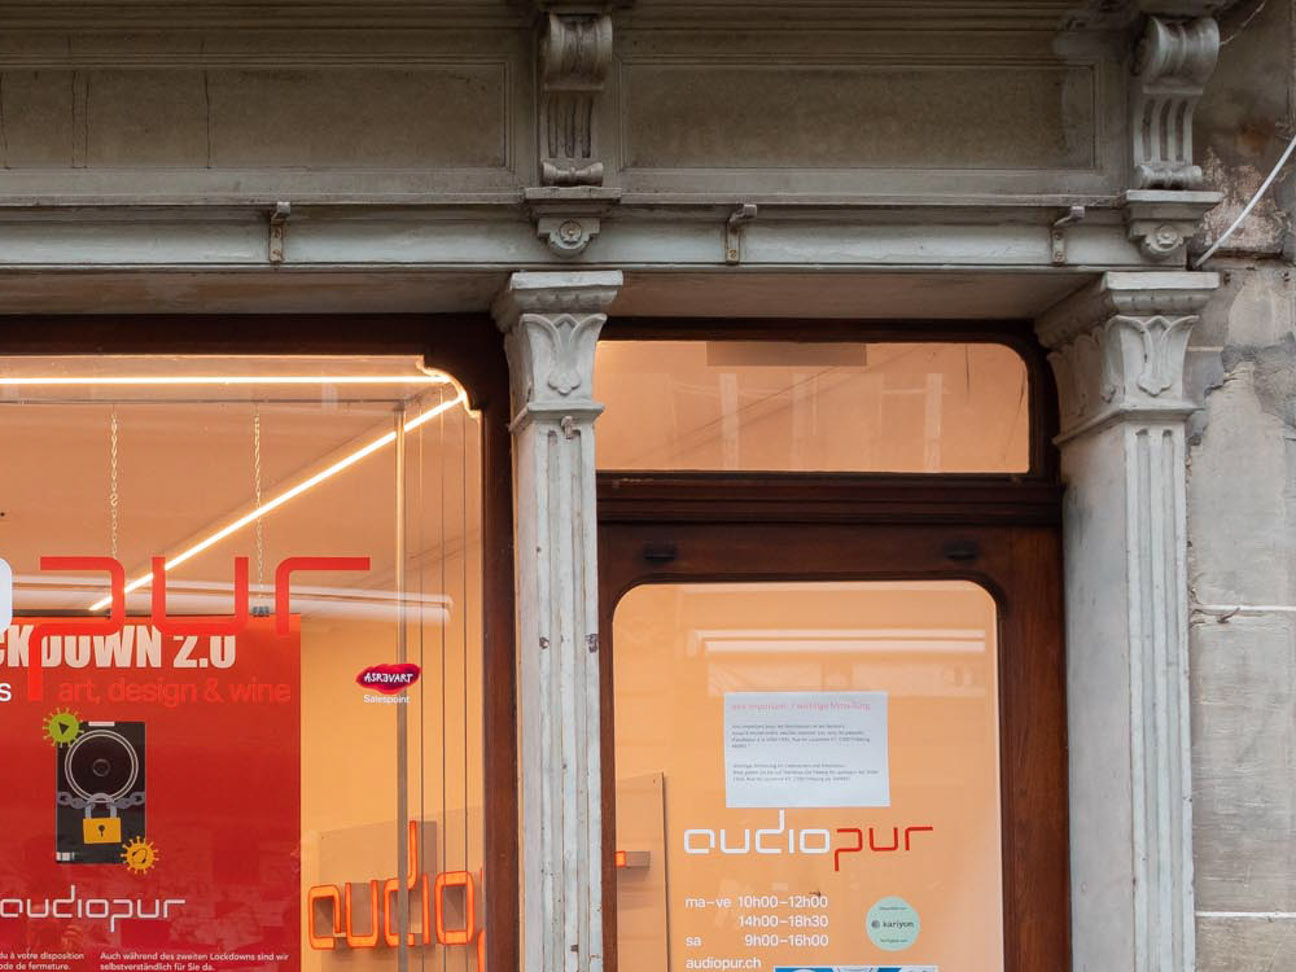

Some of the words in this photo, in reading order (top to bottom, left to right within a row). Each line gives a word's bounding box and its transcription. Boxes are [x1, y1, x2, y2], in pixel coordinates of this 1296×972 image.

[173, 635, 236, 668] 2.0
[58, 680, 101, 704] art,
[108, 677, 197, 708] design
[204, 677, 225, 702] &
[229, 677, 291, 702] wine
[684, 809, 934, 872] audiopur
[0, 885, 186, 933] audiopur
[686, 937, 701, 947] sa
[16, 951, 38, 959] votre
[40, 951, 84, 962] disposition
[100, 952, 121, 960] Auch
[122, 952, 158, 960] während
[160, 952, 174, 960] des
[176, 952, 208, 960] zweiten
[209, 952, 255, 960] Lockdowns
[257, 952, 274, 961] sind
[276, 952, 290, 961] wir
[28, 962, 72, 970] fermeture.
[100, 962, 172, 971] selbstverständlich
[174, 962, 185, 971] für
[187, 962, 200, 971] Sie
[202, 962, 216, 971] da.
[686, 957, 761, 972] audiopur.ch
